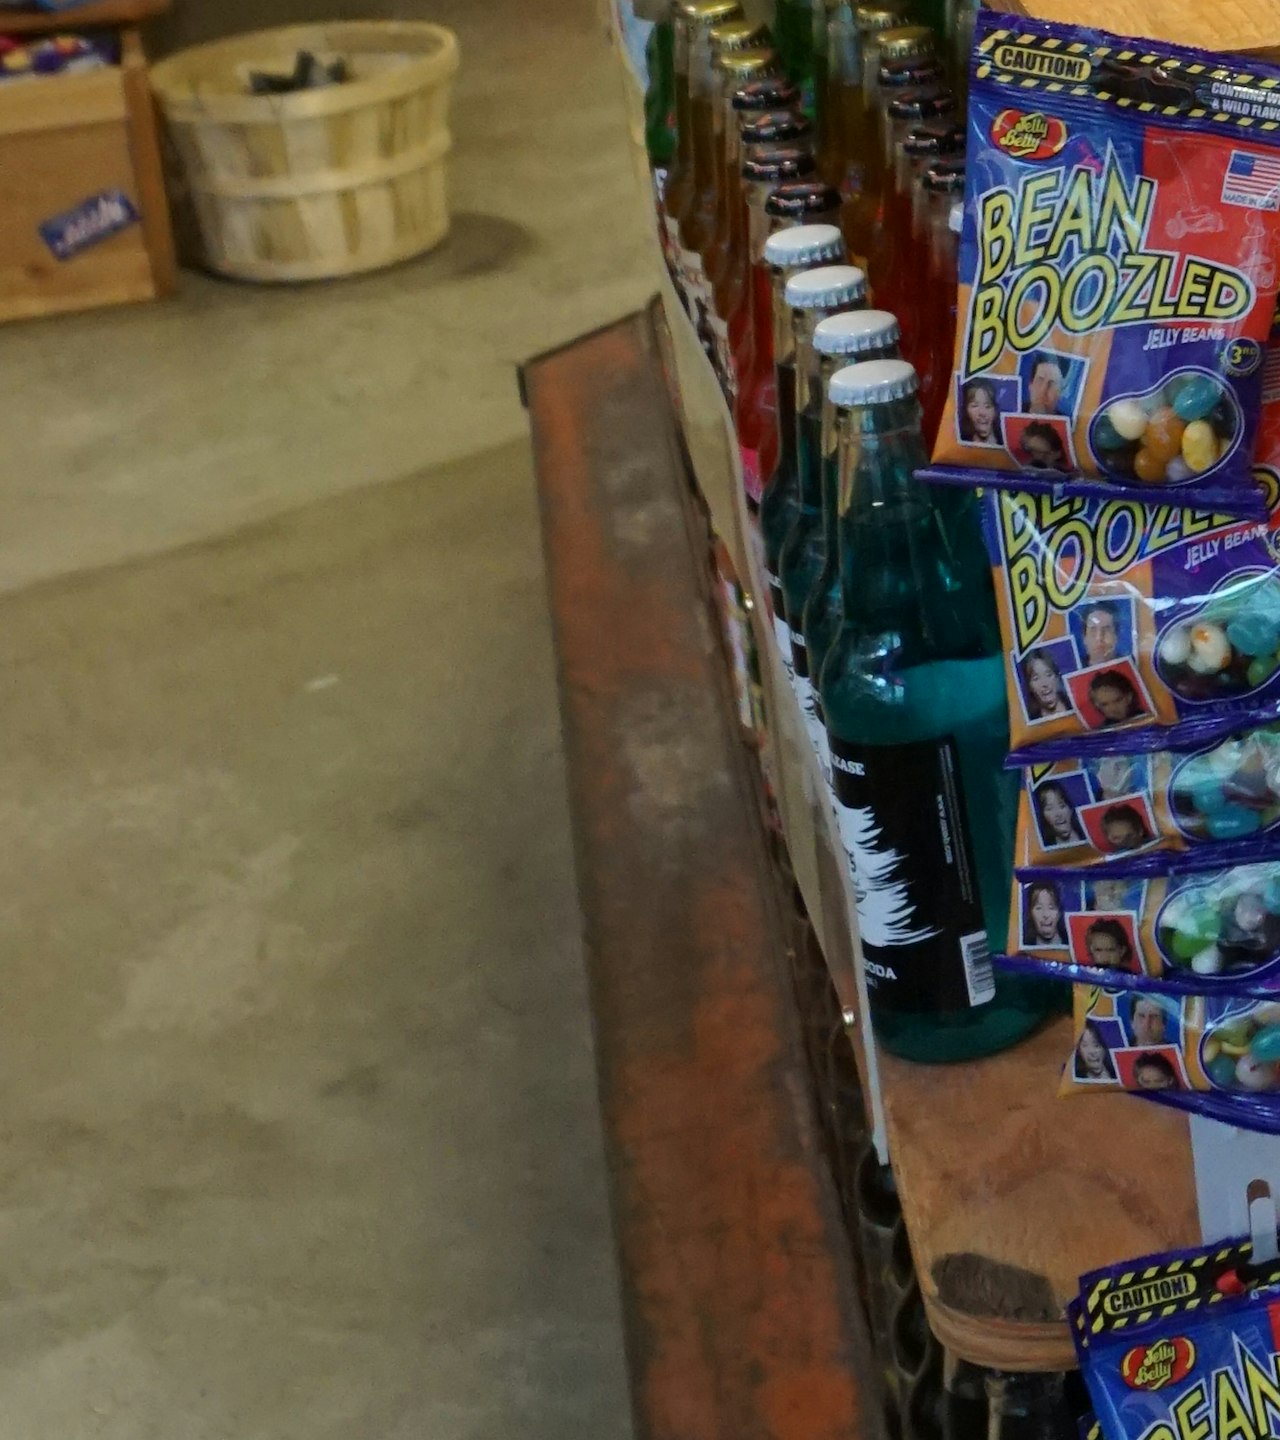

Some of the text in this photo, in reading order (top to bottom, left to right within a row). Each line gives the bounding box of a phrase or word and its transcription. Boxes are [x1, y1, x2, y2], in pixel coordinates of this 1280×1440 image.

[1000, 46, 1085, 80] CAUTION!
[1222, 100, 1251, 116] WILD
[1014, 113, 1048, 138] Jelly
[1000, 129, 1042, 151] Belly
[979, 140, 1157, 286] BEAN
[965, 252, 1255, 381] BOOZLED
[1143, 326, 1226, 351] JELLY BEANS
[1110, 1275, 1192, 1312] CAUTION!
[1143, 1343, 1177, 1370] Jelly
[1133, 1360, 1172, 1389] Belly
